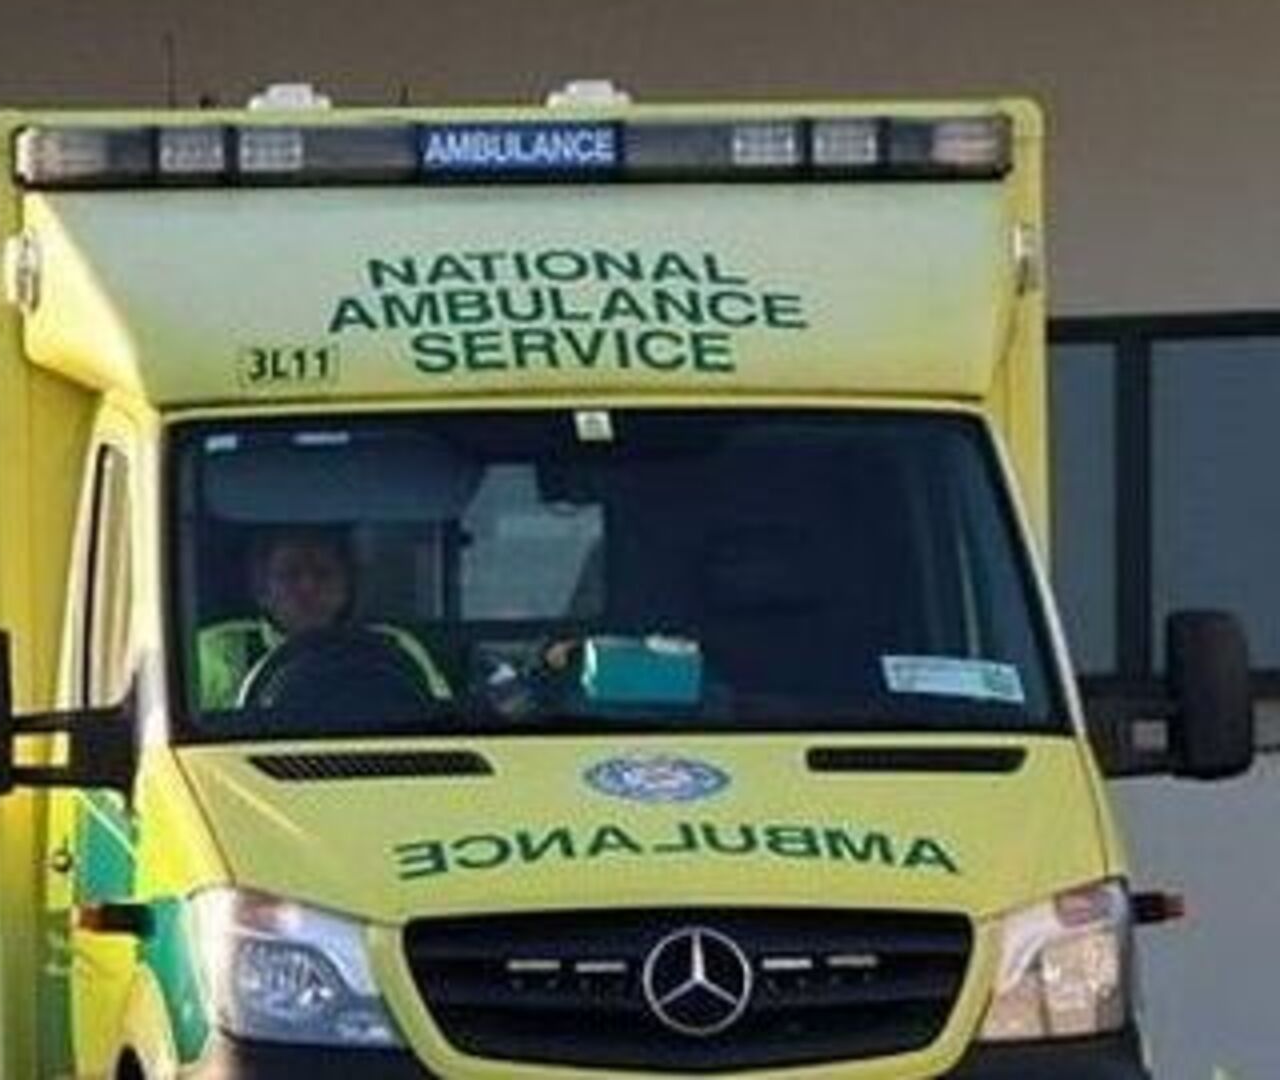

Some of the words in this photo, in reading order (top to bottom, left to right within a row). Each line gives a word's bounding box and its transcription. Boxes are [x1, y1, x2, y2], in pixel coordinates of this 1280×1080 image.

[423, 129, 616, 165] AMBULANCE
[367, 248, 748, 288] NATIONAL
[327, 287, 809, 333] AMBULANCE
[247, 348, 330, 381] 3L11
[409, 328, 736, 374] SERVICE
